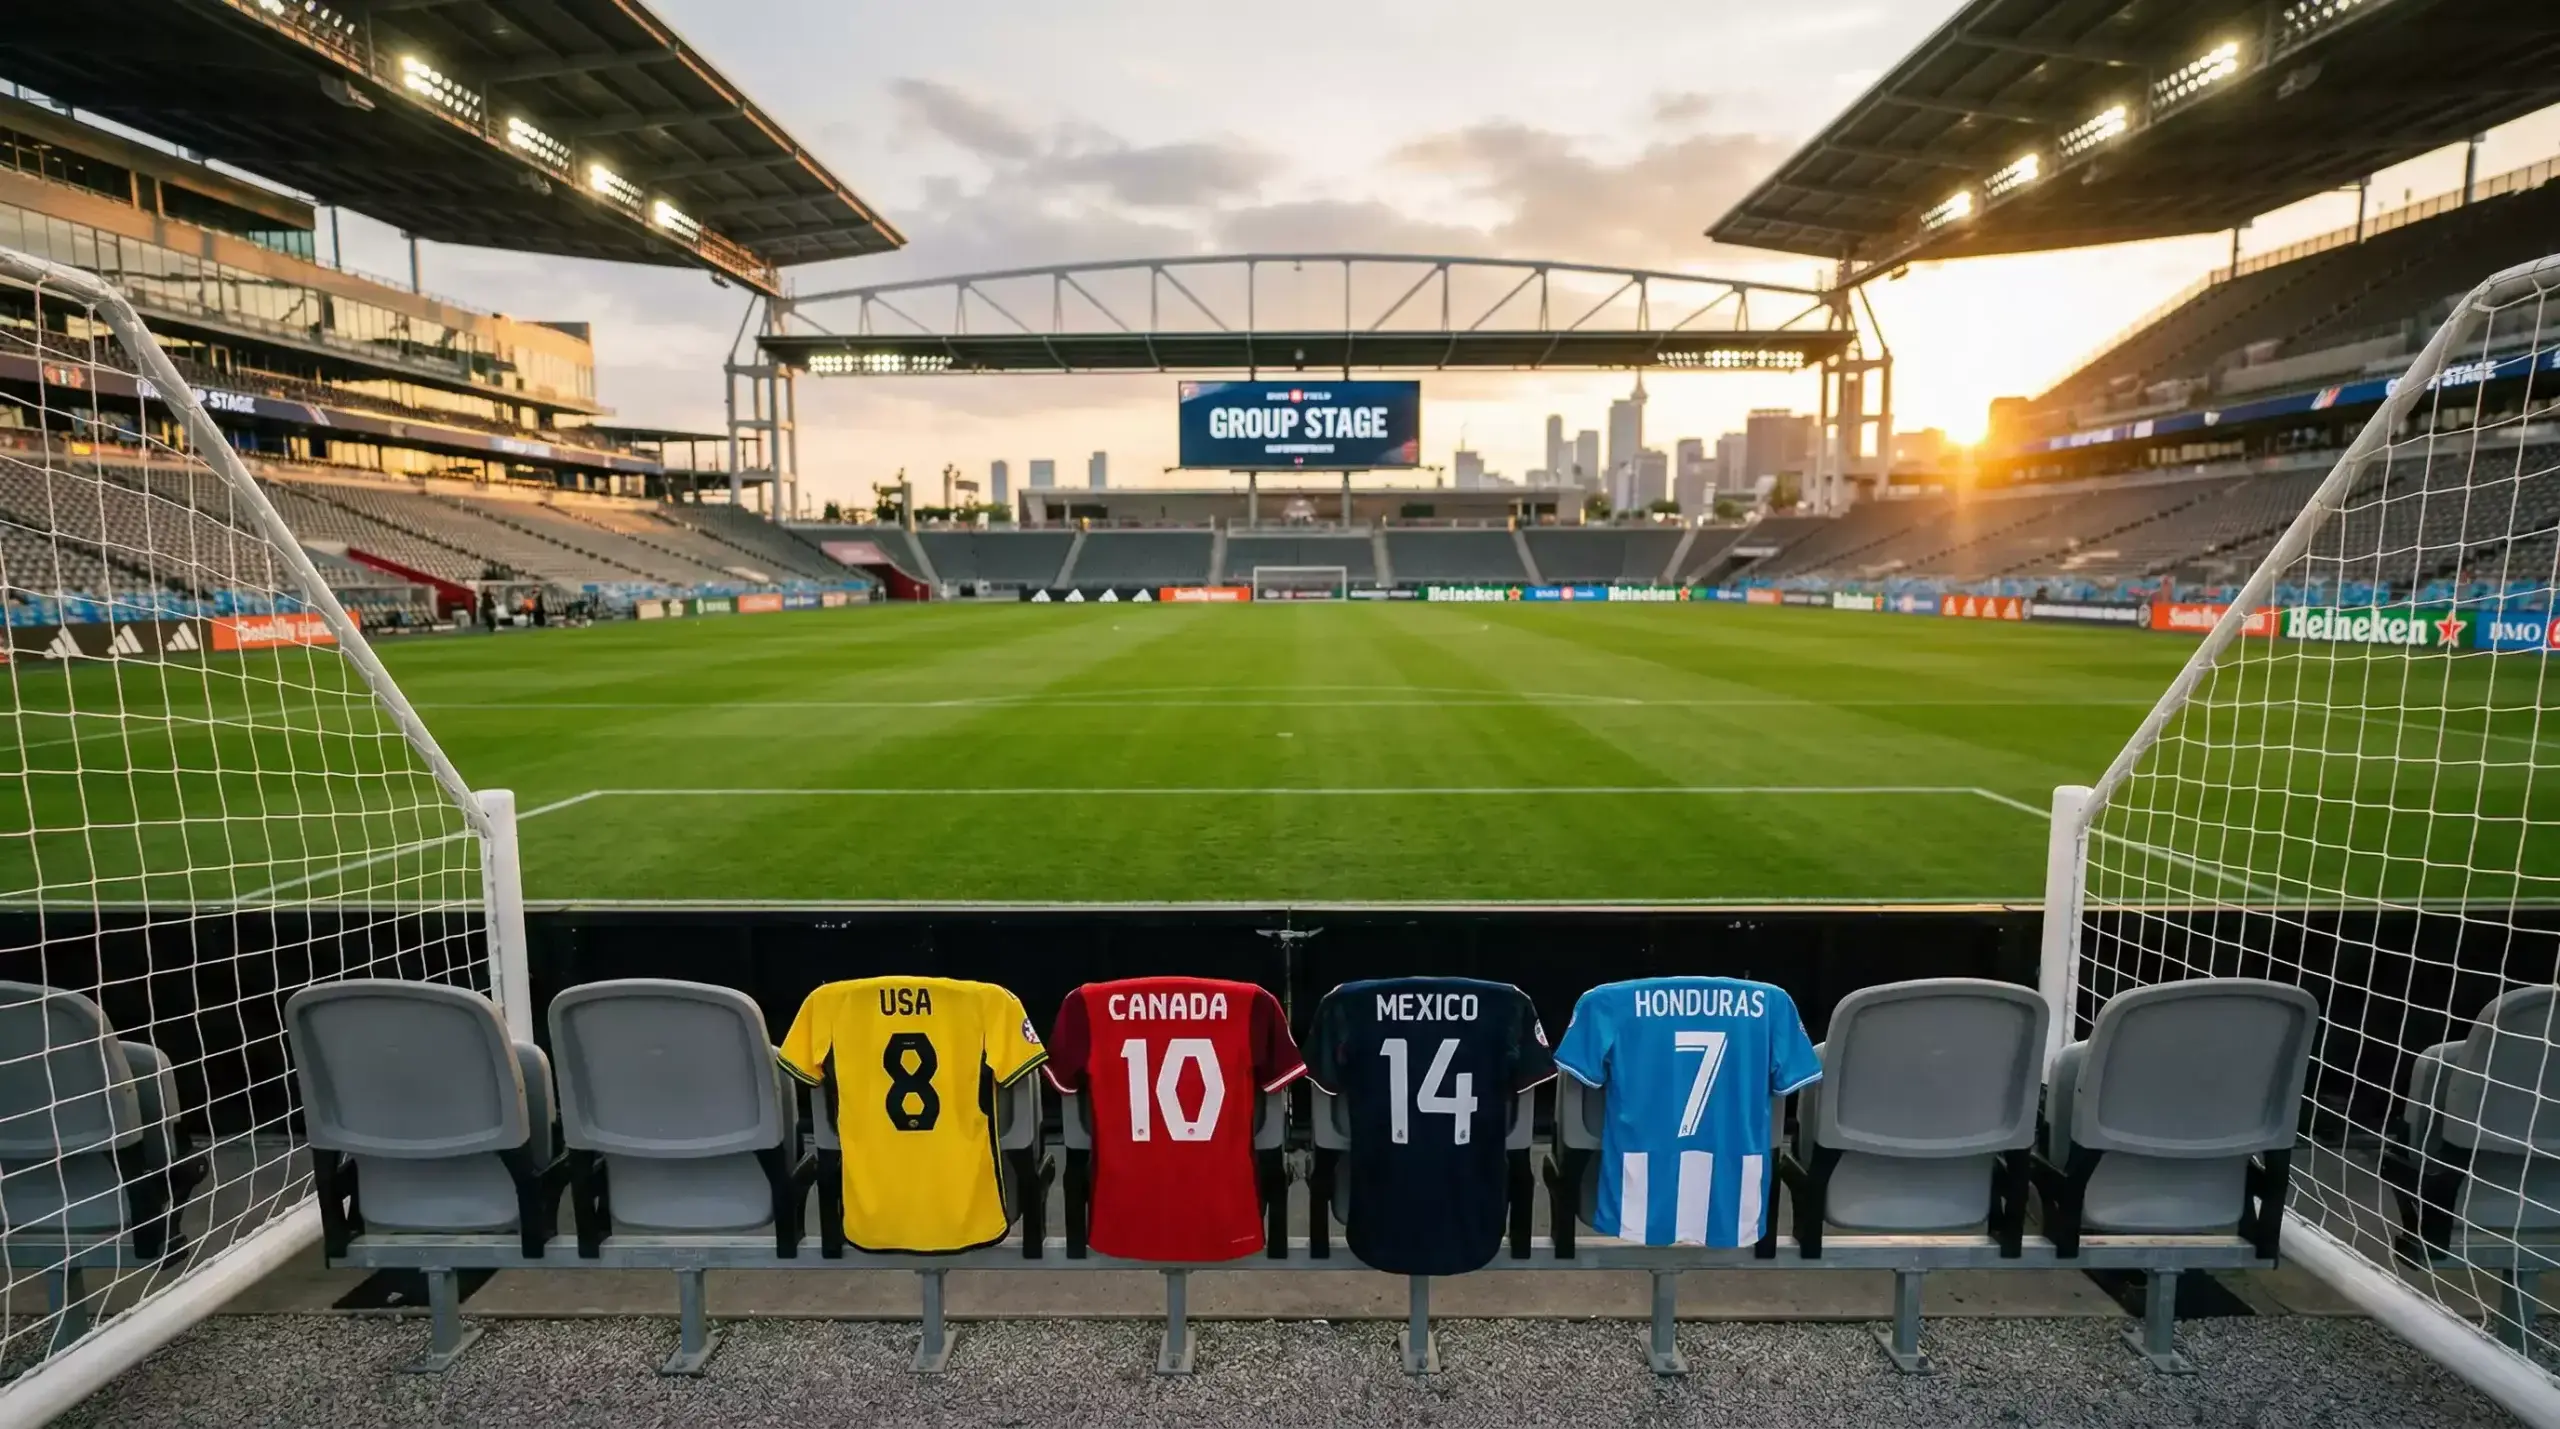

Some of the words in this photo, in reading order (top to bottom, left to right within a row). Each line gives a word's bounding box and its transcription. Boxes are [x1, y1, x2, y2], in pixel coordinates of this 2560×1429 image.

[1209, 407, 1299, 439] GROUP
[1304, 407, 1388, 439] STAGE
[2287, 607, 2427, 645] Heineken
[879, 988, 932, 1016] USA
[1108, 992, 1228, 1020] CANADA
[1376, 993, 1479, 1021] MEXICO
[1635, 988, 1765, 1018] HONDURAS
[883, 1032, 940, 1131] 8
[1120, 1038, 1226, 1142] 10
[1379, 1038, 1478, 1145] 14
[1675, 1031, 1728, 1138] 7
